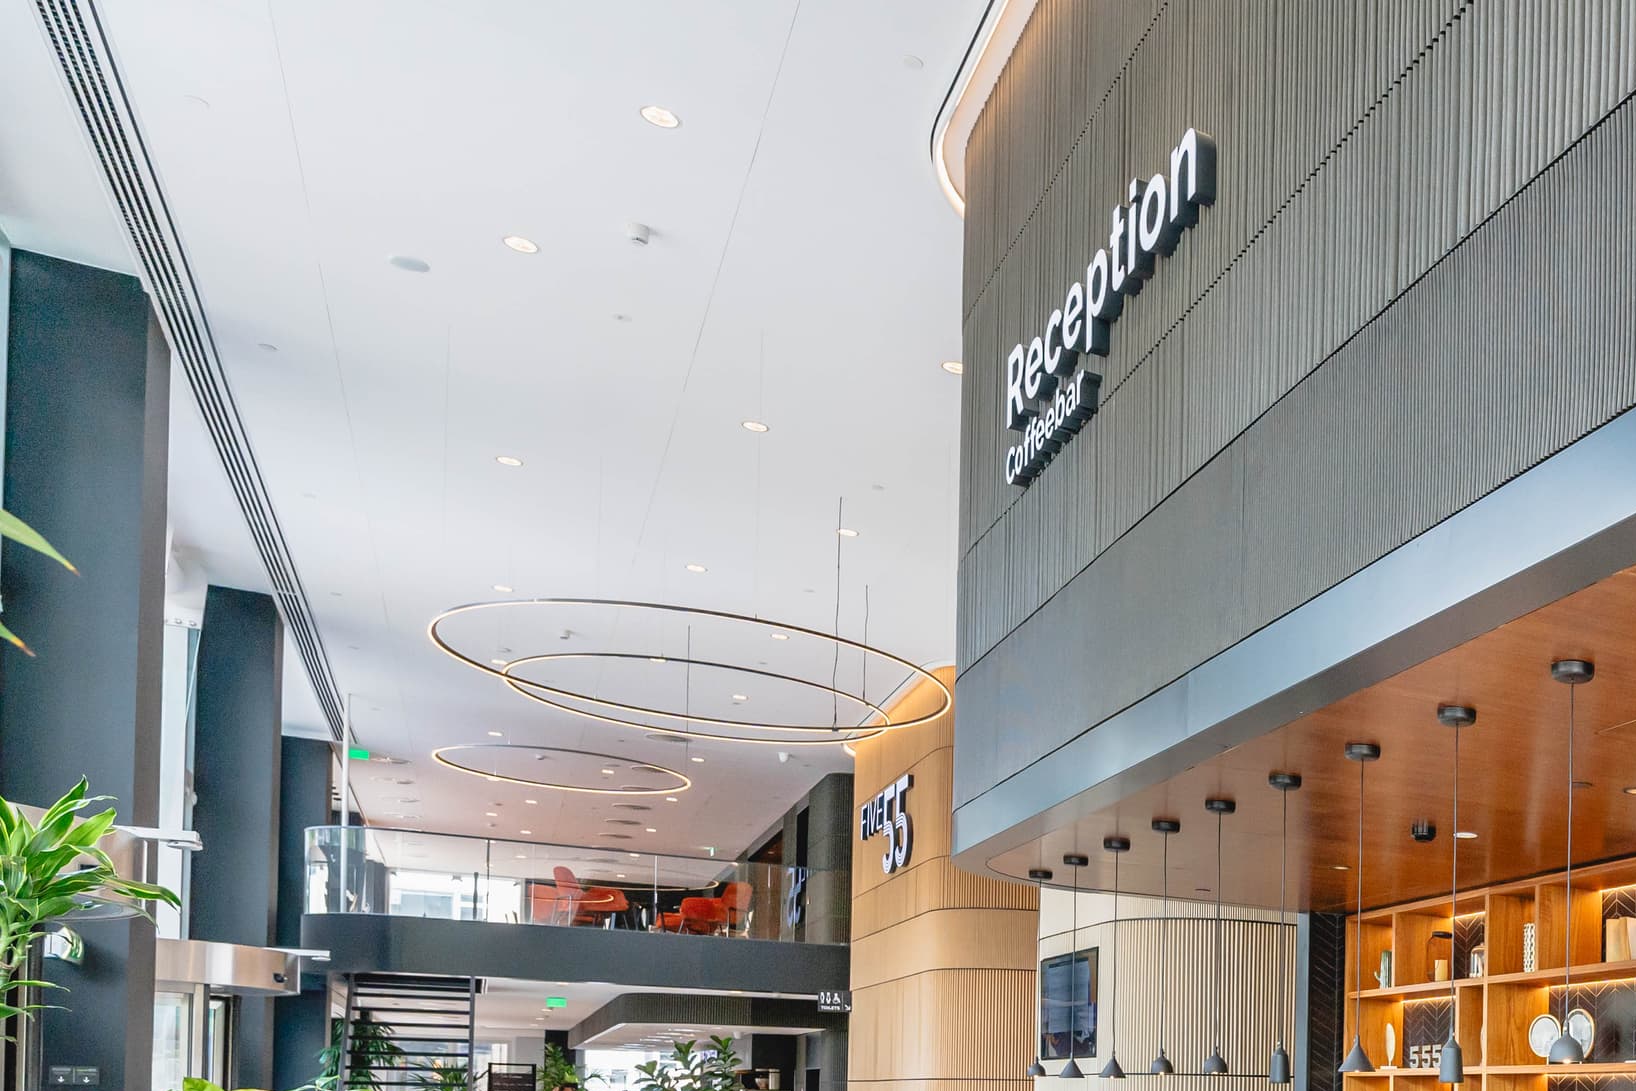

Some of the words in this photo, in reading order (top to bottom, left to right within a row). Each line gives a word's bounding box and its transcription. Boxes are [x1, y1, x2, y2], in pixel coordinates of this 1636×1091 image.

[1006, 127, 1198, 430] Reception
[1005, 369, 1085, 486] Coffeebar
[1409, 1044, 1442, 1068] 555
